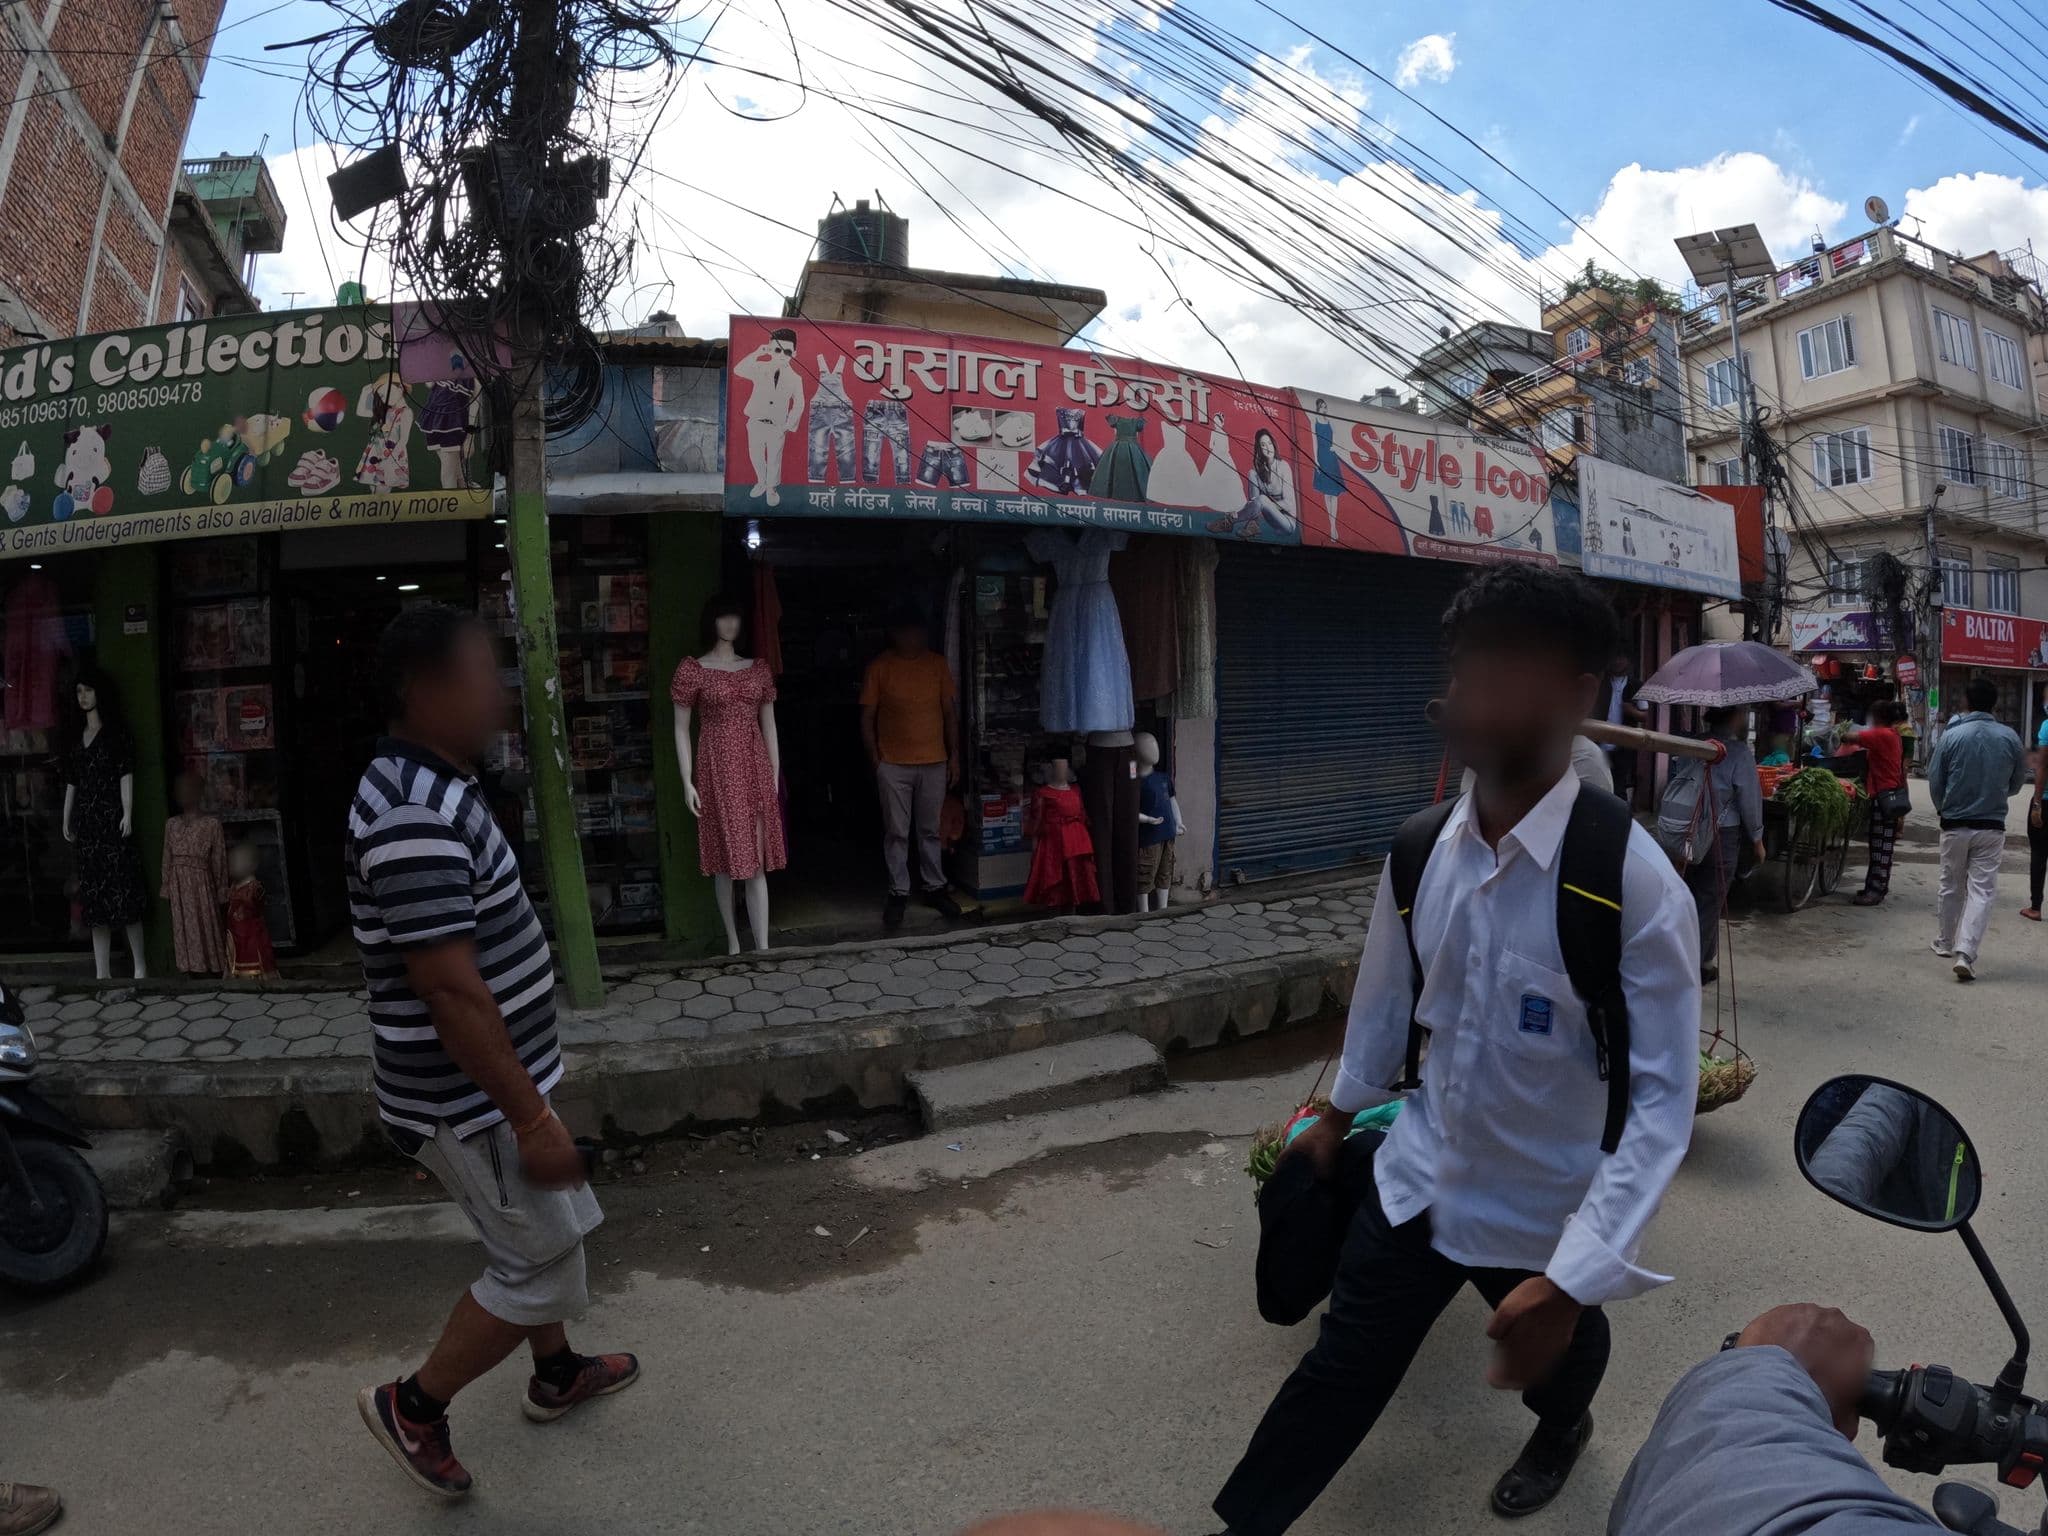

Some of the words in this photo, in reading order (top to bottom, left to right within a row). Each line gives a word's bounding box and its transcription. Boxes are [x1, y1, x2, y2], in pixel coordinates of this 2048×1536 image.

[89, 313, 399, 387] Collection
[853, 339, 1043, 400] भुसाल
[0, 396, 91, 429] 851096370,
[97, 381, 203, 414] 9808509478
[1349, 421, 1463, 493] Style
[1475, 451, 1549, 506] Icon
[12, 528, 58, 551] Gents
[63, 513, 191, 544] Undergarments
[197, 508, 234, 530] also
[239, 502, 323, 526] available
[329, 498, 343, 520] &
[348, 500, 403, 522] many
[408, 496, 459, 515] more
[808, 486, 836, 512] यहाँ
[844, 487, 895, 514] लेडिज,
[904, 491, 942, 516] जेन्स,
[1103, 507, 1142, 525] सामान
[1965, 614, 2015, 643] BALTRA
